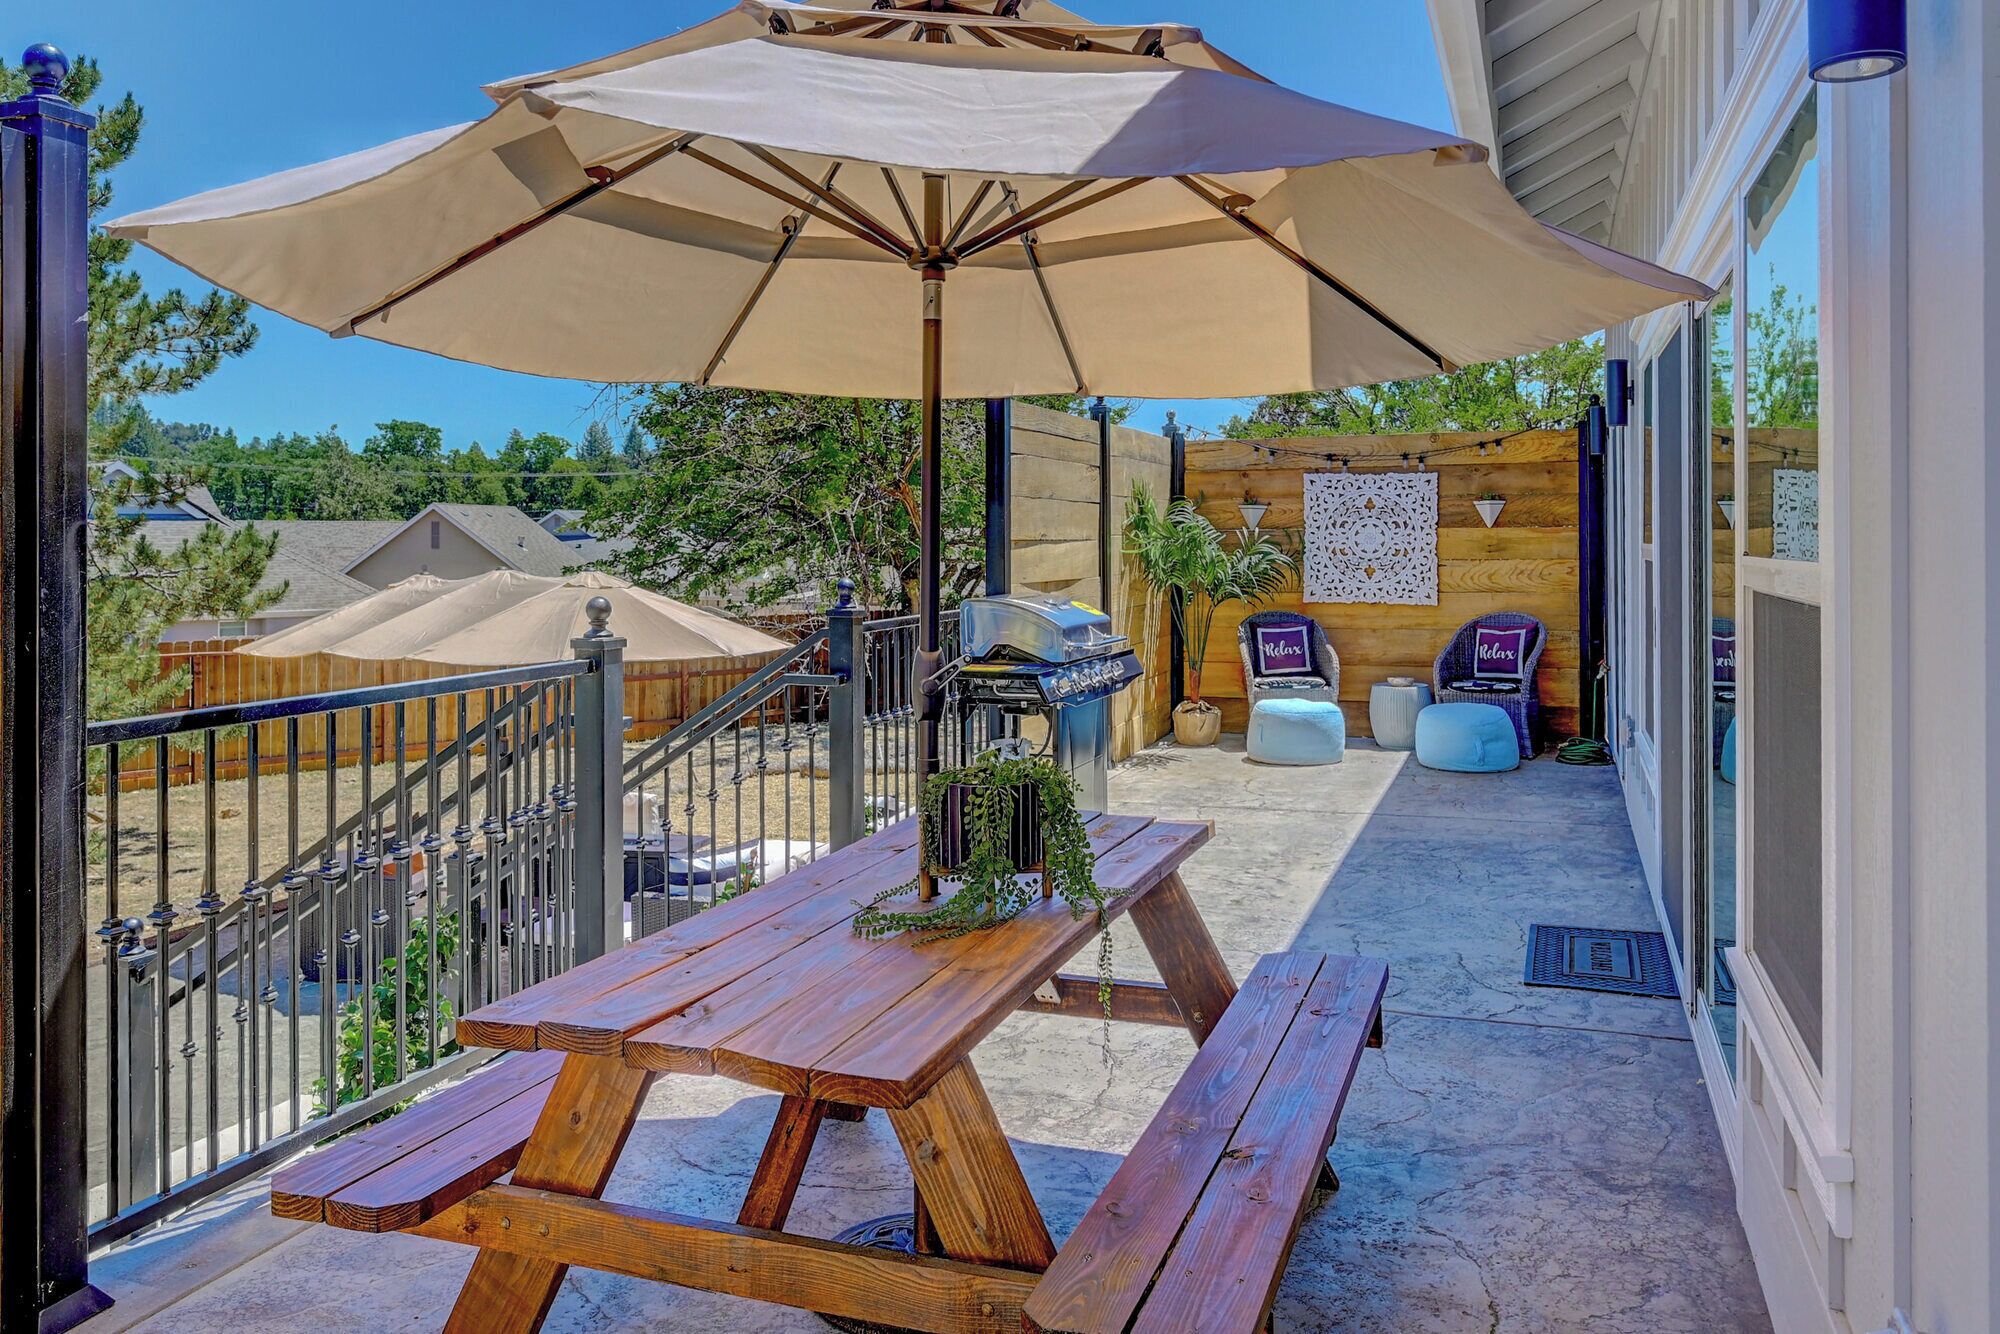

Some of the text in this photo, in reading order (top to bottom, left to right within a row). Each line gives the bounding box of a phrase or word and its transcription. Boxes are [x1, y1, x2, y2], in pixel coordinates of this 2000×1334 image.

[1264, 640, 1303, 657] Relax
[1479, 642, 1517, 660] Relax
[1590, 942, 1613, 972] WELCOME
